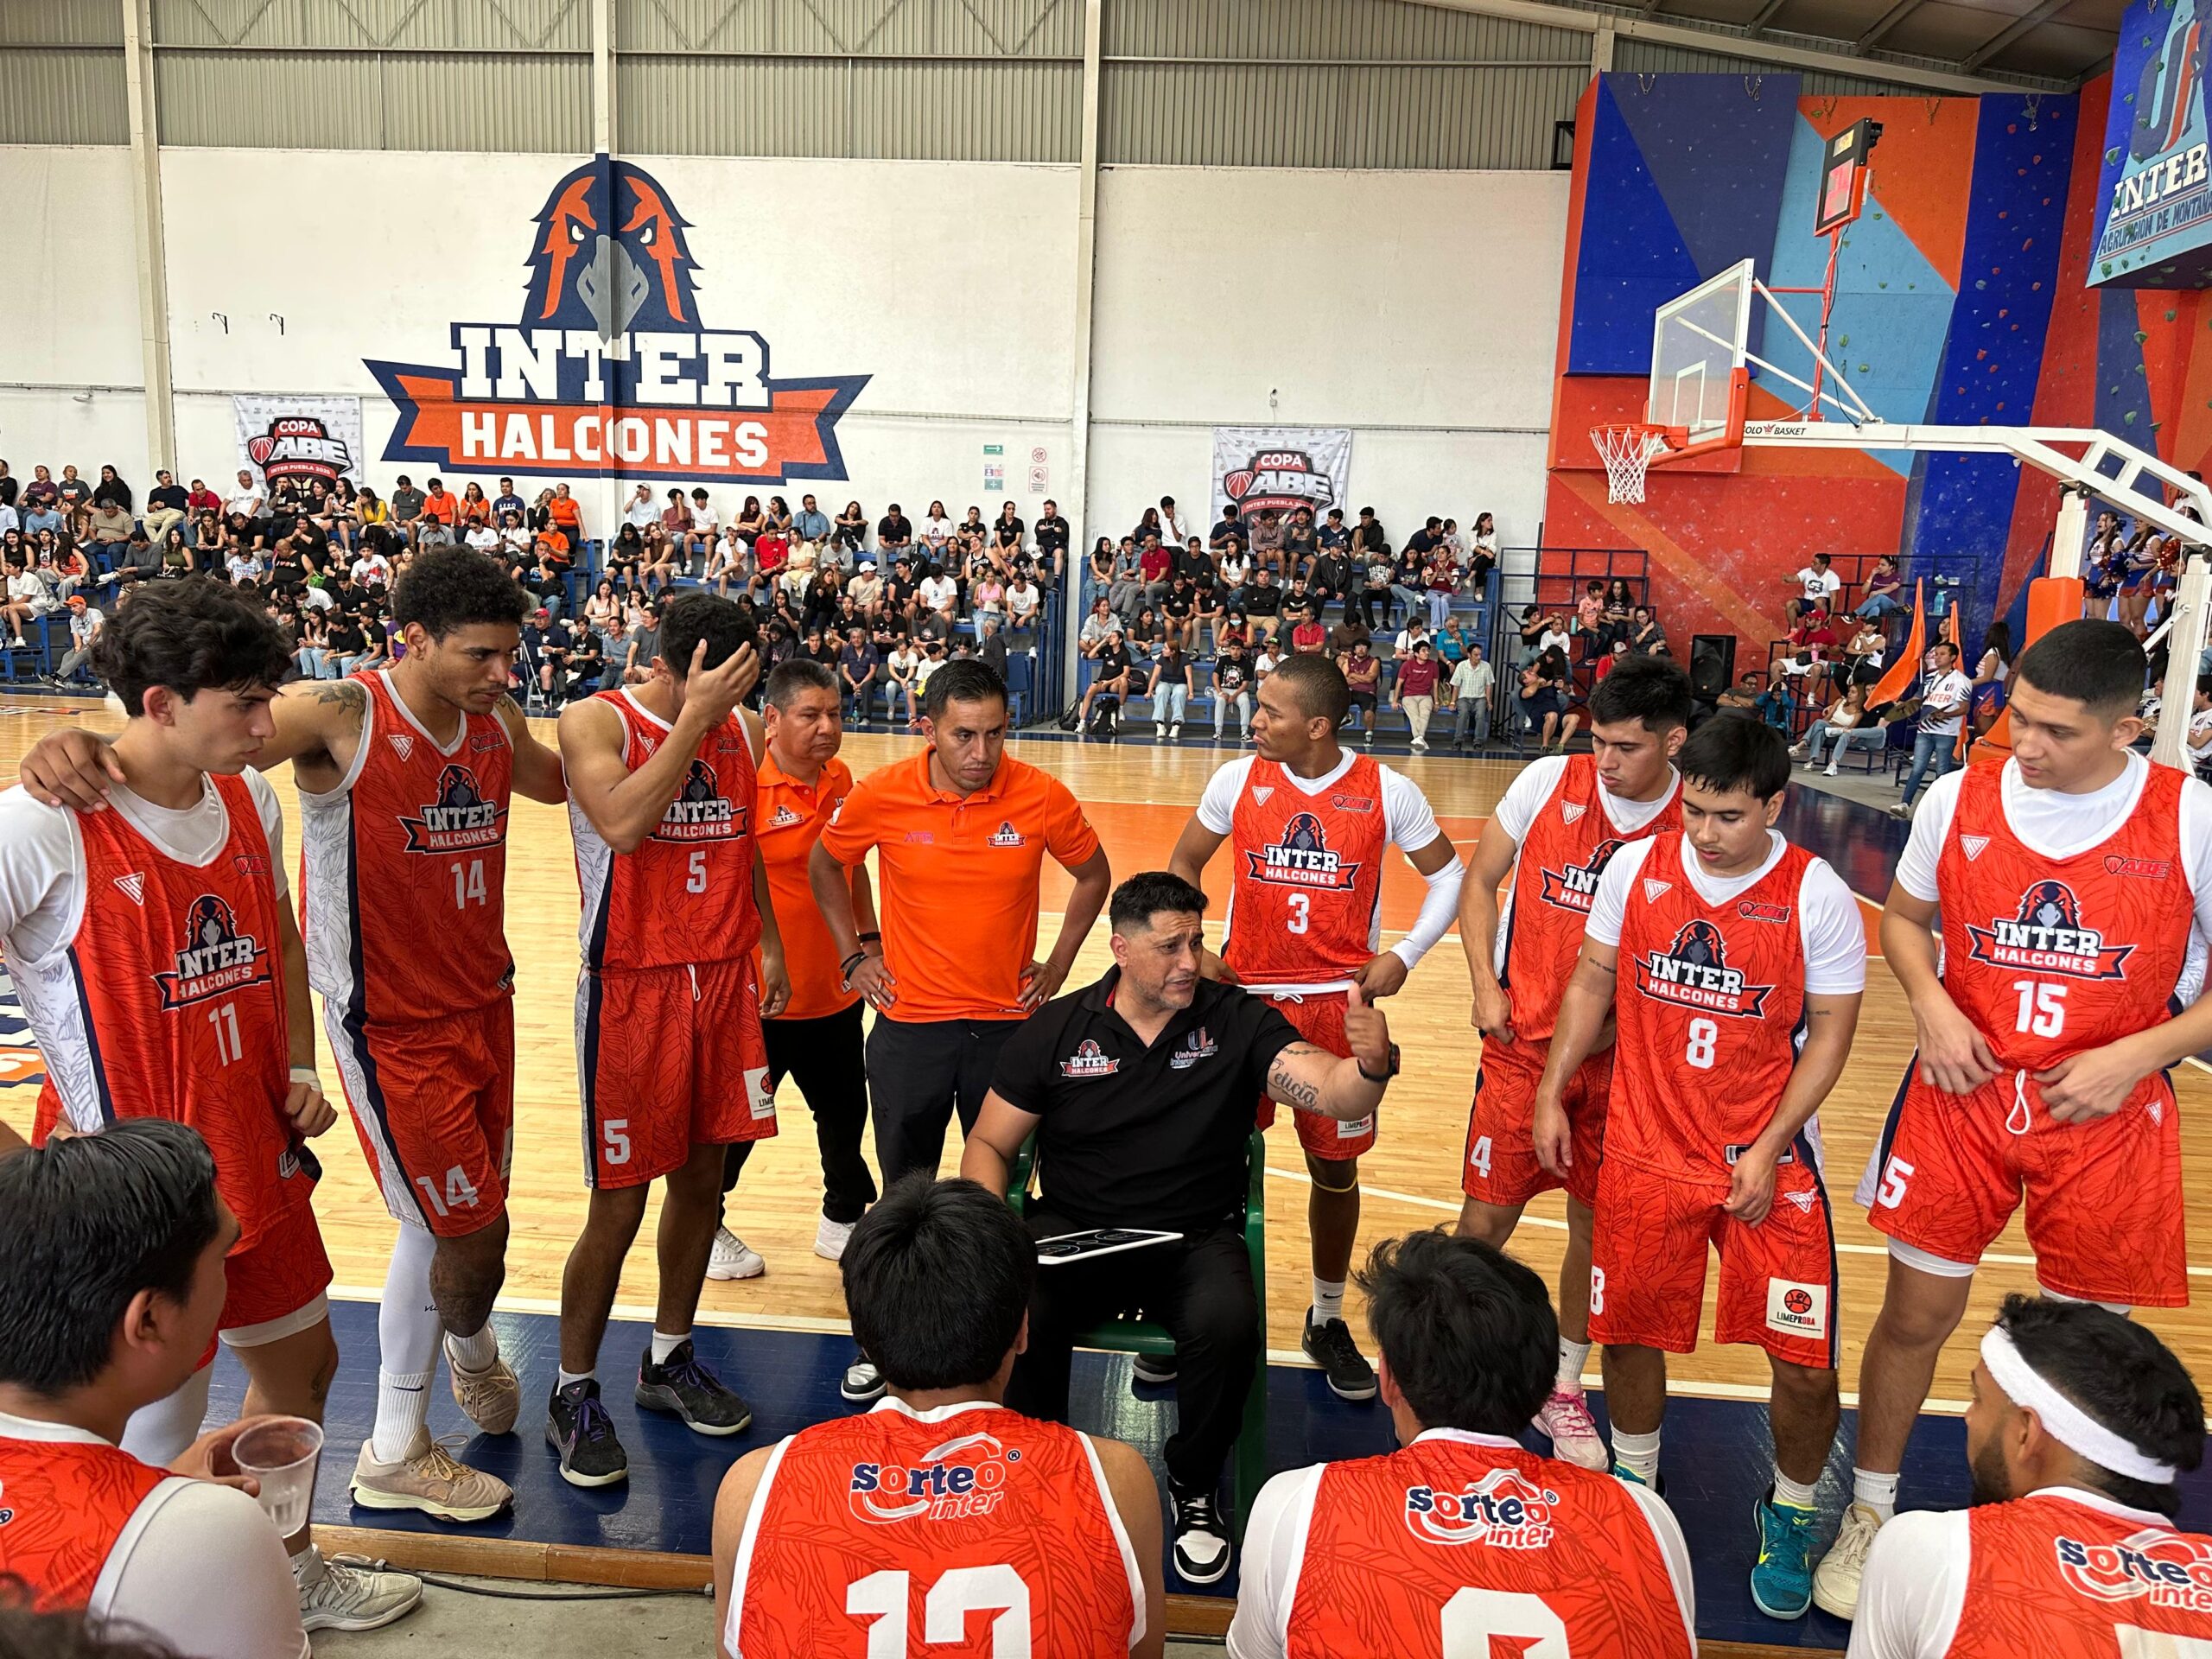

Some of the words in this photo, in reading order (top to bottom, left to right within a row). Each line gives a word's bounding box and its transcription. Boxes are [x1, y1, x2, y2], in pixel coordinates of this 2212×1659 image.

[2111, 143, 2206, 219] INTER
[2156, 208, 2170, 232] DE
[461, 327, 768, 407] INTER
[278, 420, 318, 434] COPA
[461, 411, 768, 467] HALCONES
[1744, 426, 1763, 435] OLO
[1774, 427, 1807, 435] BASKET
[269, 436, 351, 467] ABE
[1261, 454, 1302, 467] COPA
[270, 466, 289, 474] INTER
[1245, 470, 1332, 501] ABE
[1927, 693, 1952, 703] NTER
[424, 803, 495, 831] INTER
[663, 800, 732, 823] INTER
[430, 829, 499, 847] HALCONES
[660, 823, 732, 837] HALCONES
[686, 851, 707, 893] 5
[1267, 847, 1338, 873] INTER
[451, 859, 486, 910] 14
[1265, 867, 1336, 885] HALCONES
[1287, 893, 1310, 934] 3
[1994, 921, 2101, 957] INTER
[178, 938, 254, 981] INTER
[1650, 954, 1743, 995] INTER
[1993, 947, 2096, 973] HALCONES
[180, 965, 252, 998] HALCONES
[1649, 979, 1738, 1009] HALCONES
[2013, 980, 2068, 1038] 15
[208, 1002, 243, 1067] 11
[1686, 1017, 1717, 1069] 8
[1071, 1058, 1108, 1067] INTER
[604, 1119, 631, 1164] 5
[1471, 1135, 1492, 1178] 4
[416, 1165, 478, 1216] 14
[1590, 1265, 1605, 1315] 8
[1777, 1312, 1815, 1326] LIMEPROBA
[929, 1491, 1003, 1520] inter
[1485, 1525, 1554, 1549] inter
